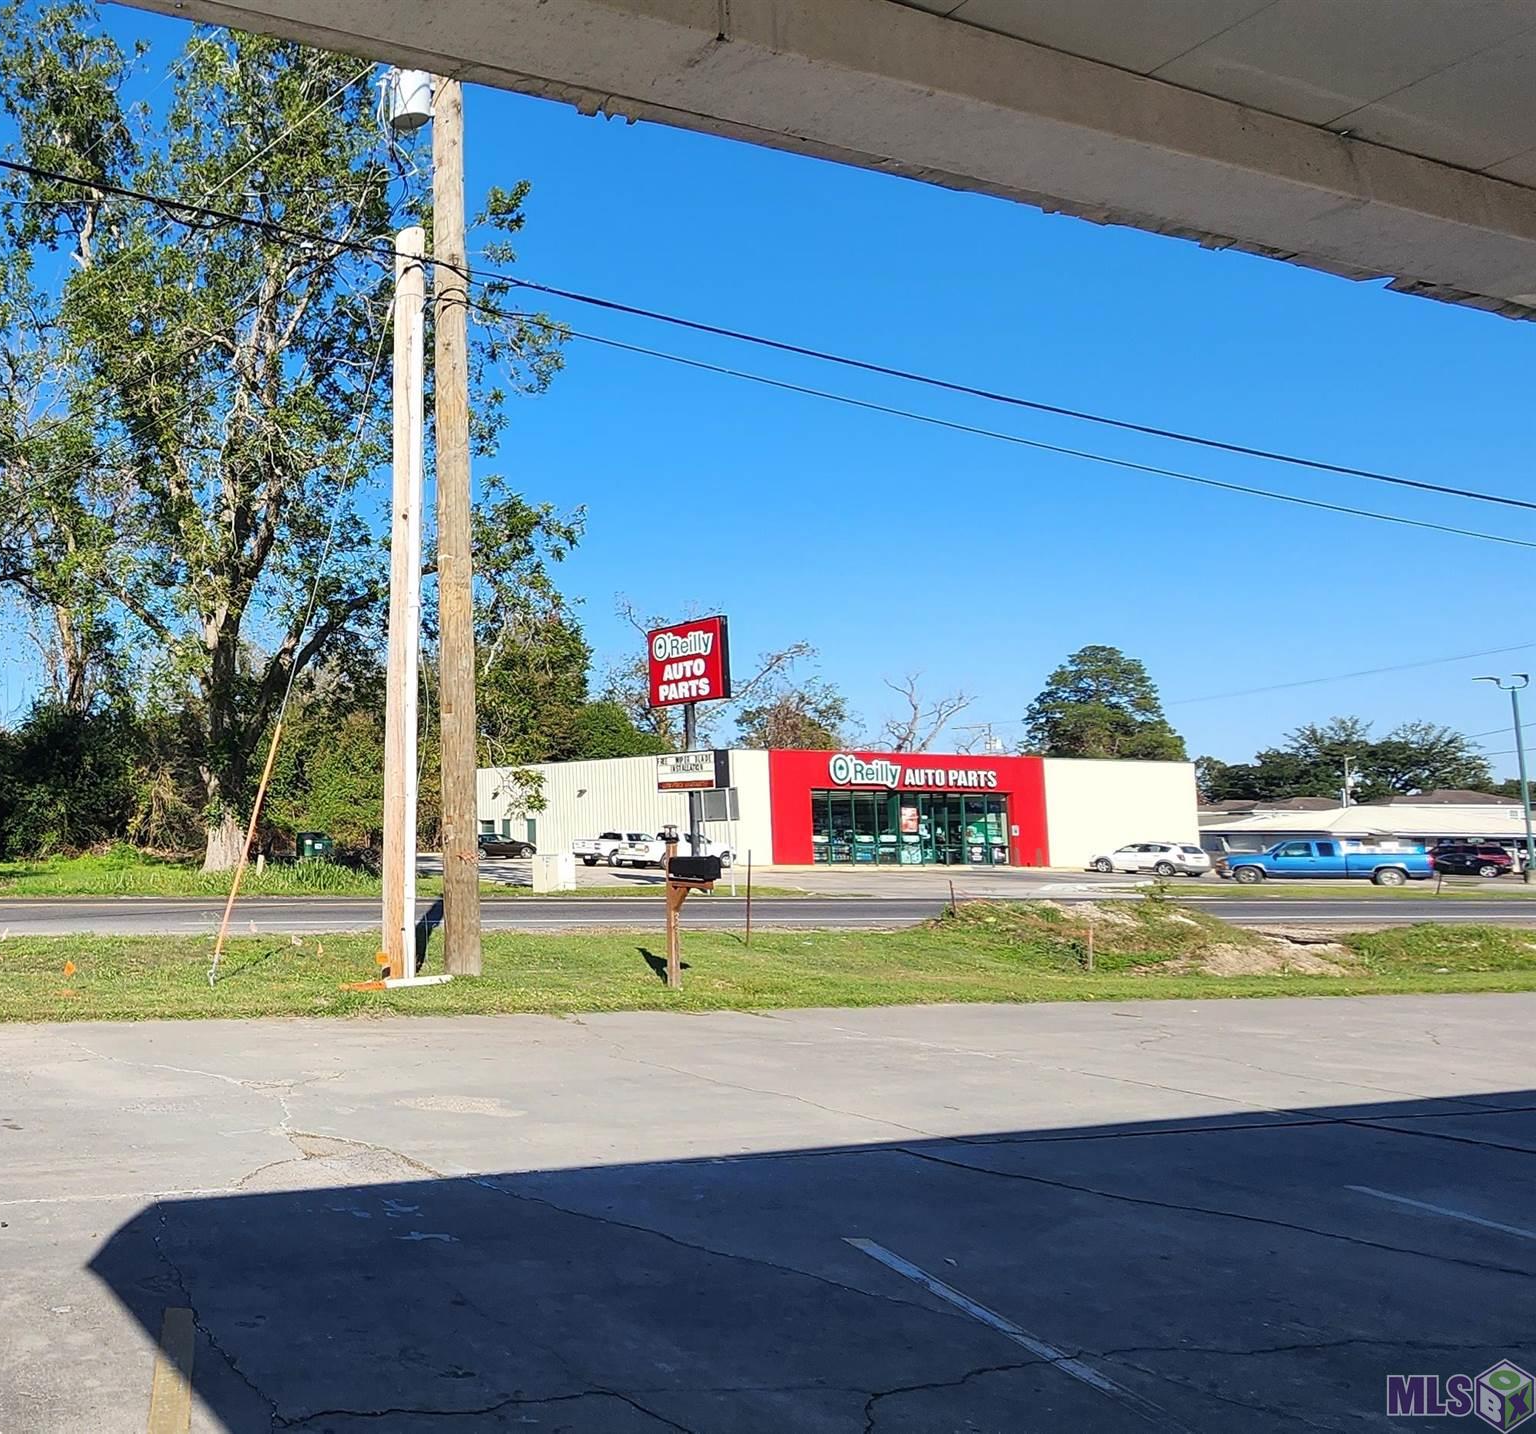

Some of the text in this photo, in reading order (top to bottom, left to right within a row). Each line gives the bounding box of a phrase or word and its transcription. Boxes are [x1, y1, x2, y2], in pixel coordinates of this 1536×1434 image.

[653, 631, 713, 661] O'Reilly
[663, 658, 706, 682] AUTO
[658, 678, 710, 702] PARTS
[830, 753, 997, 788] O'Reilly AUTO PARTS
